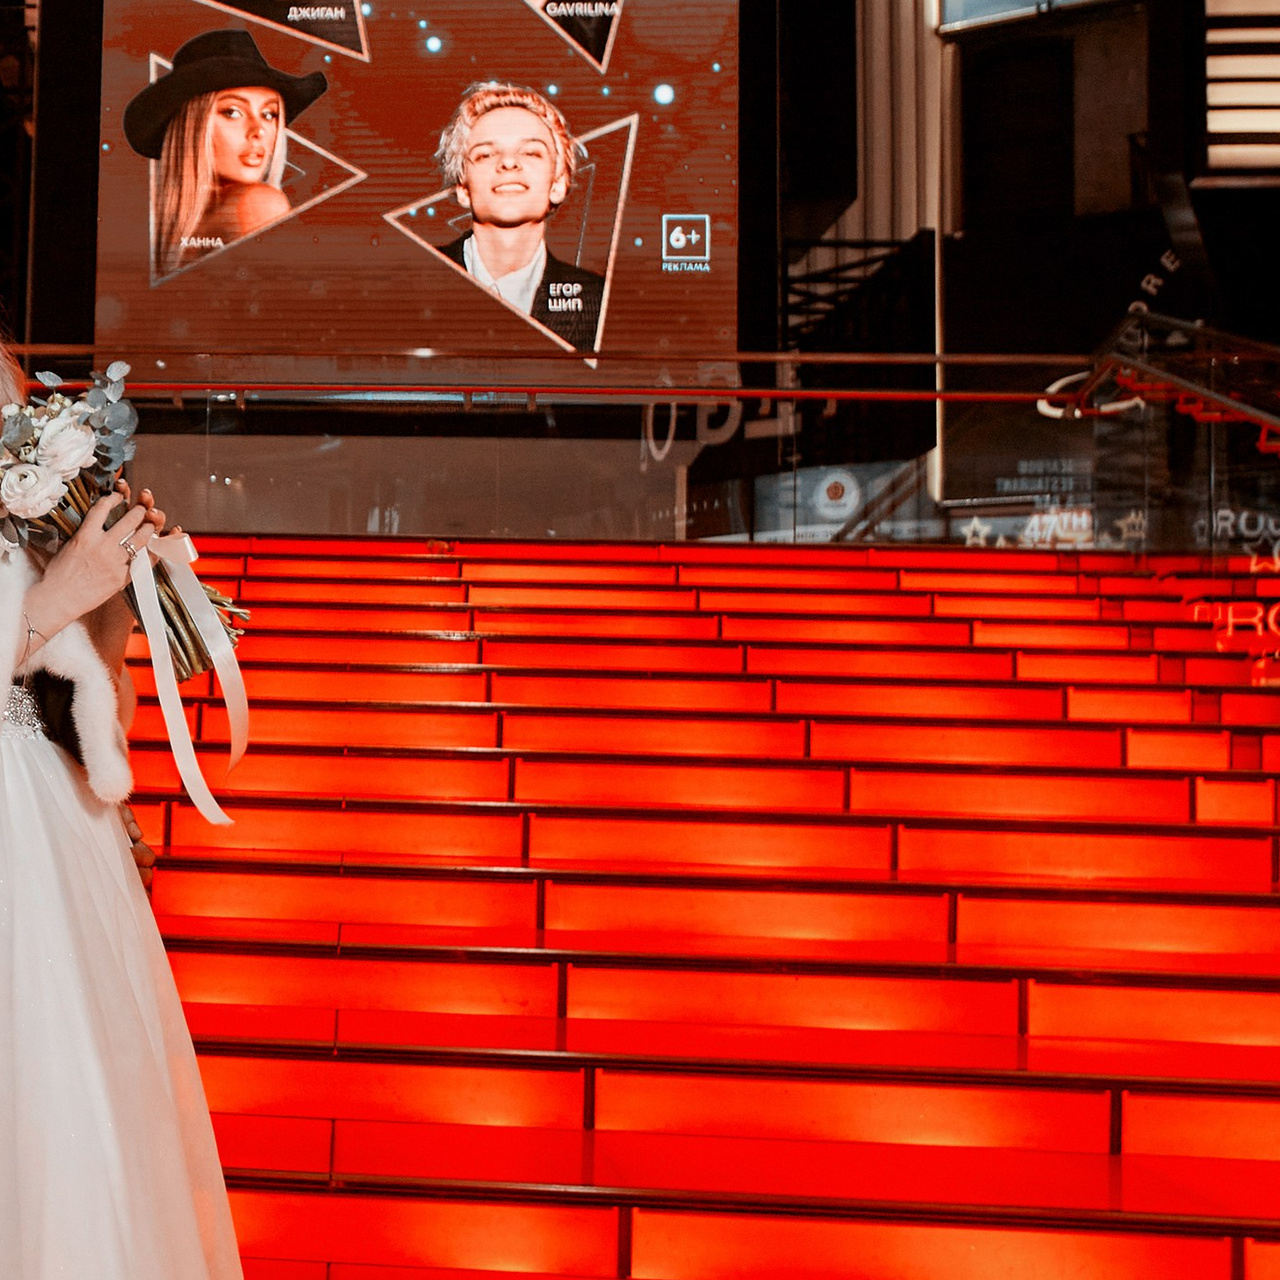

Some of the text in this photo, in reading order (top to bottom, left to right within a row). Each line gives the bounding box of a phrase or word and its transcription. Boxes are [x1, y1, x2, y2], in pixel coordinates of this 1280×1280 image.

[287, 6, 346, 21] ДЖИГАН
[546, 1, 620, 18] GAVRILINA
[180, 236, 225, 249] ХАННА
[669, 225, 701, 249] 6+
[661, 262, 710, 272] РЕКЛАМА
[549, 283, 582, 297] ЕГОР
[548, 298, 583, 311] ШИП
